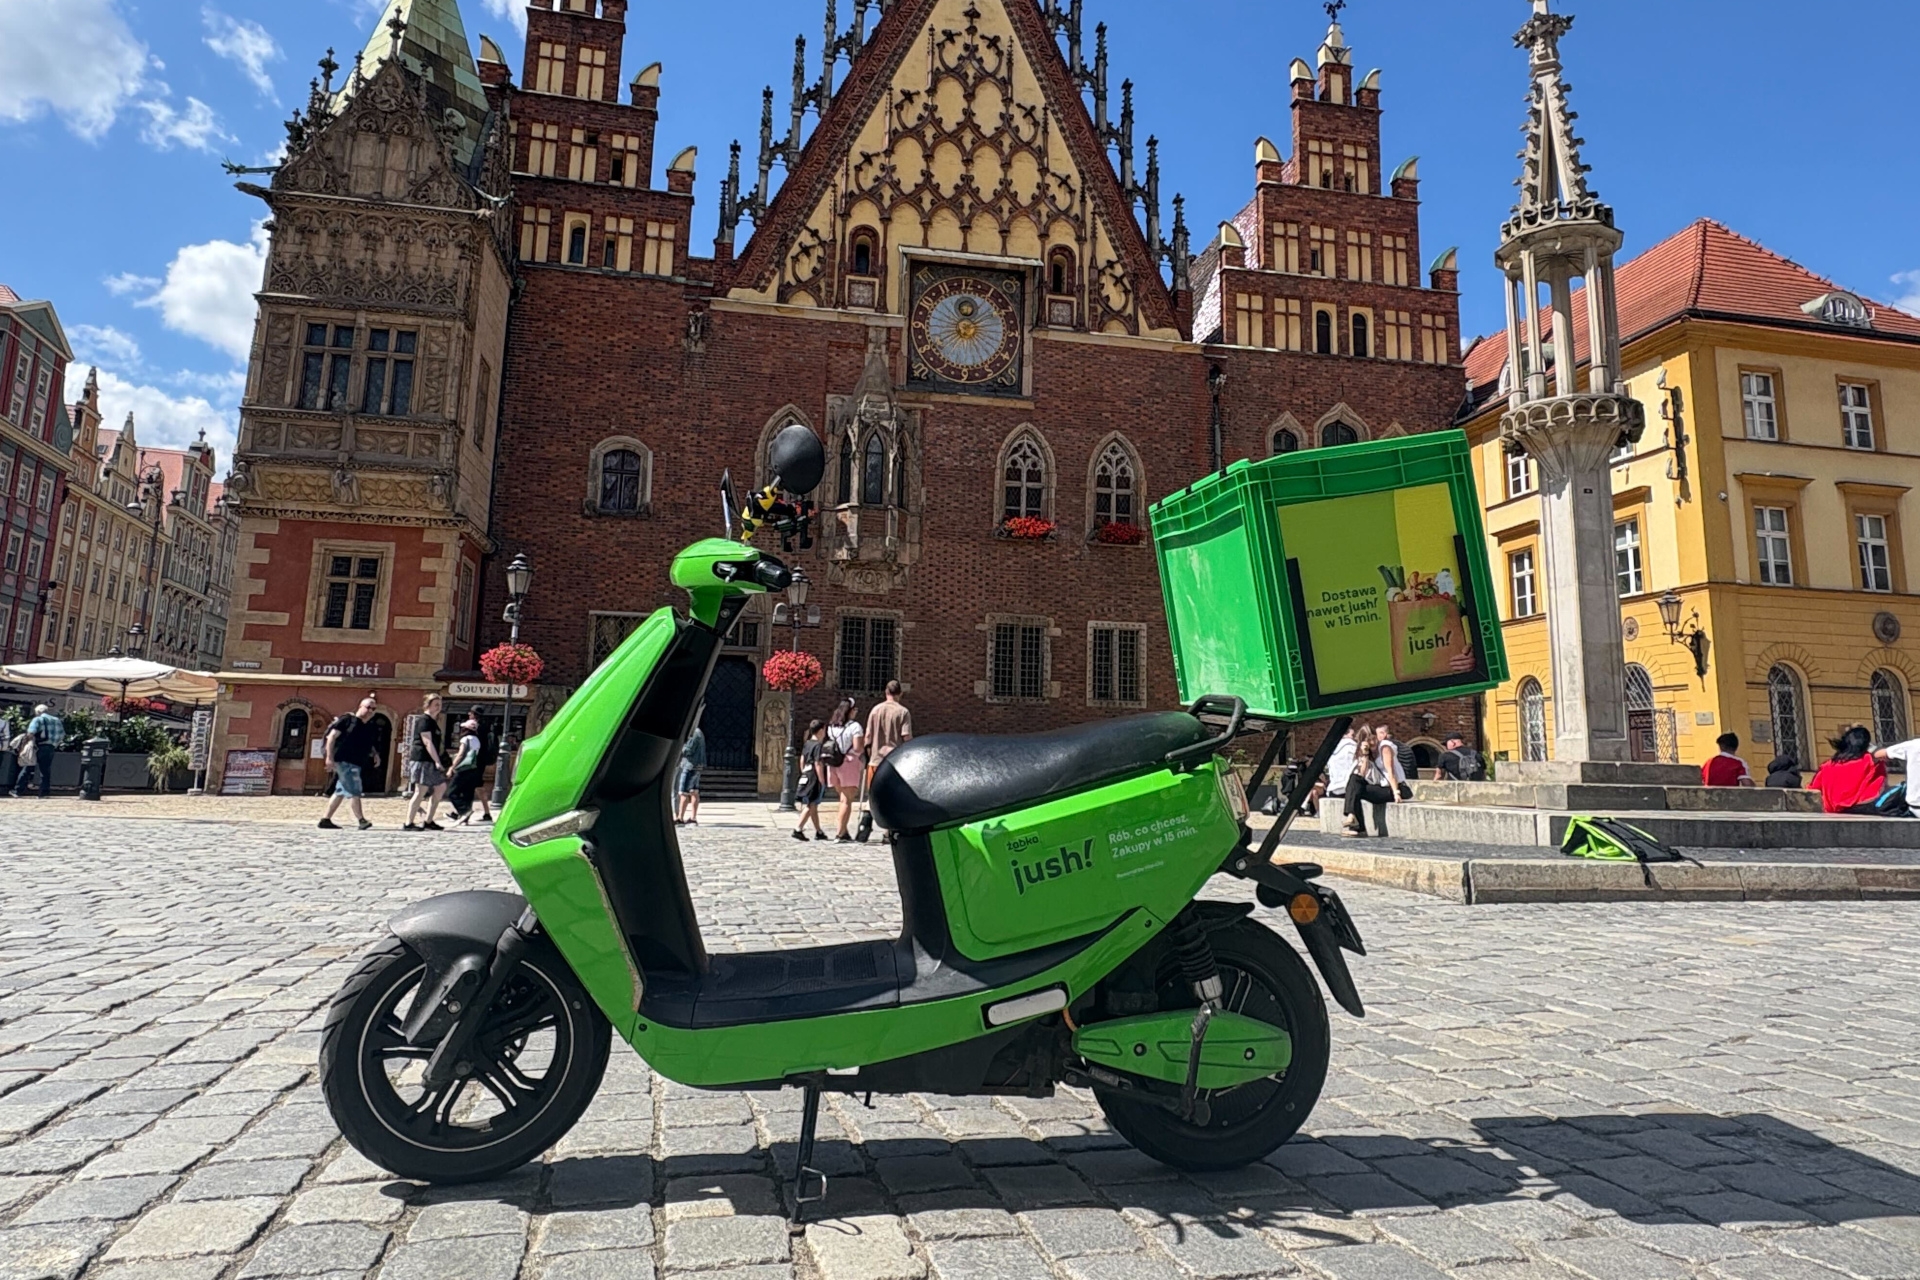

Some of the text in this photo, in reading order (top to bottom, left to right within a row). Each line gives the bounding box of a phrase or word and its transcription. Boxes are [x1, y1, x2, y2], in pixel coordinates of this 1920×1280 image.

[1321, 586, 1377, 603] Dostawa
[1306, 597, 1378, 618] nawet jush!
[1324, 611, 1382, 629] w 15 min.
[1408, 630, 1452, 655] jush!
[301, 660, 379, 678] Pamiątki
[456, 684, 521, 695] SOUVENIS
[1108, 813, 1189, 844] Rób, co chcesz.
[1006, 835, 1039, 852] żabka
[1111, 826, 1199, 858] Zakupy w 15 min.
[1011, 838, 1094, 896] jush!
